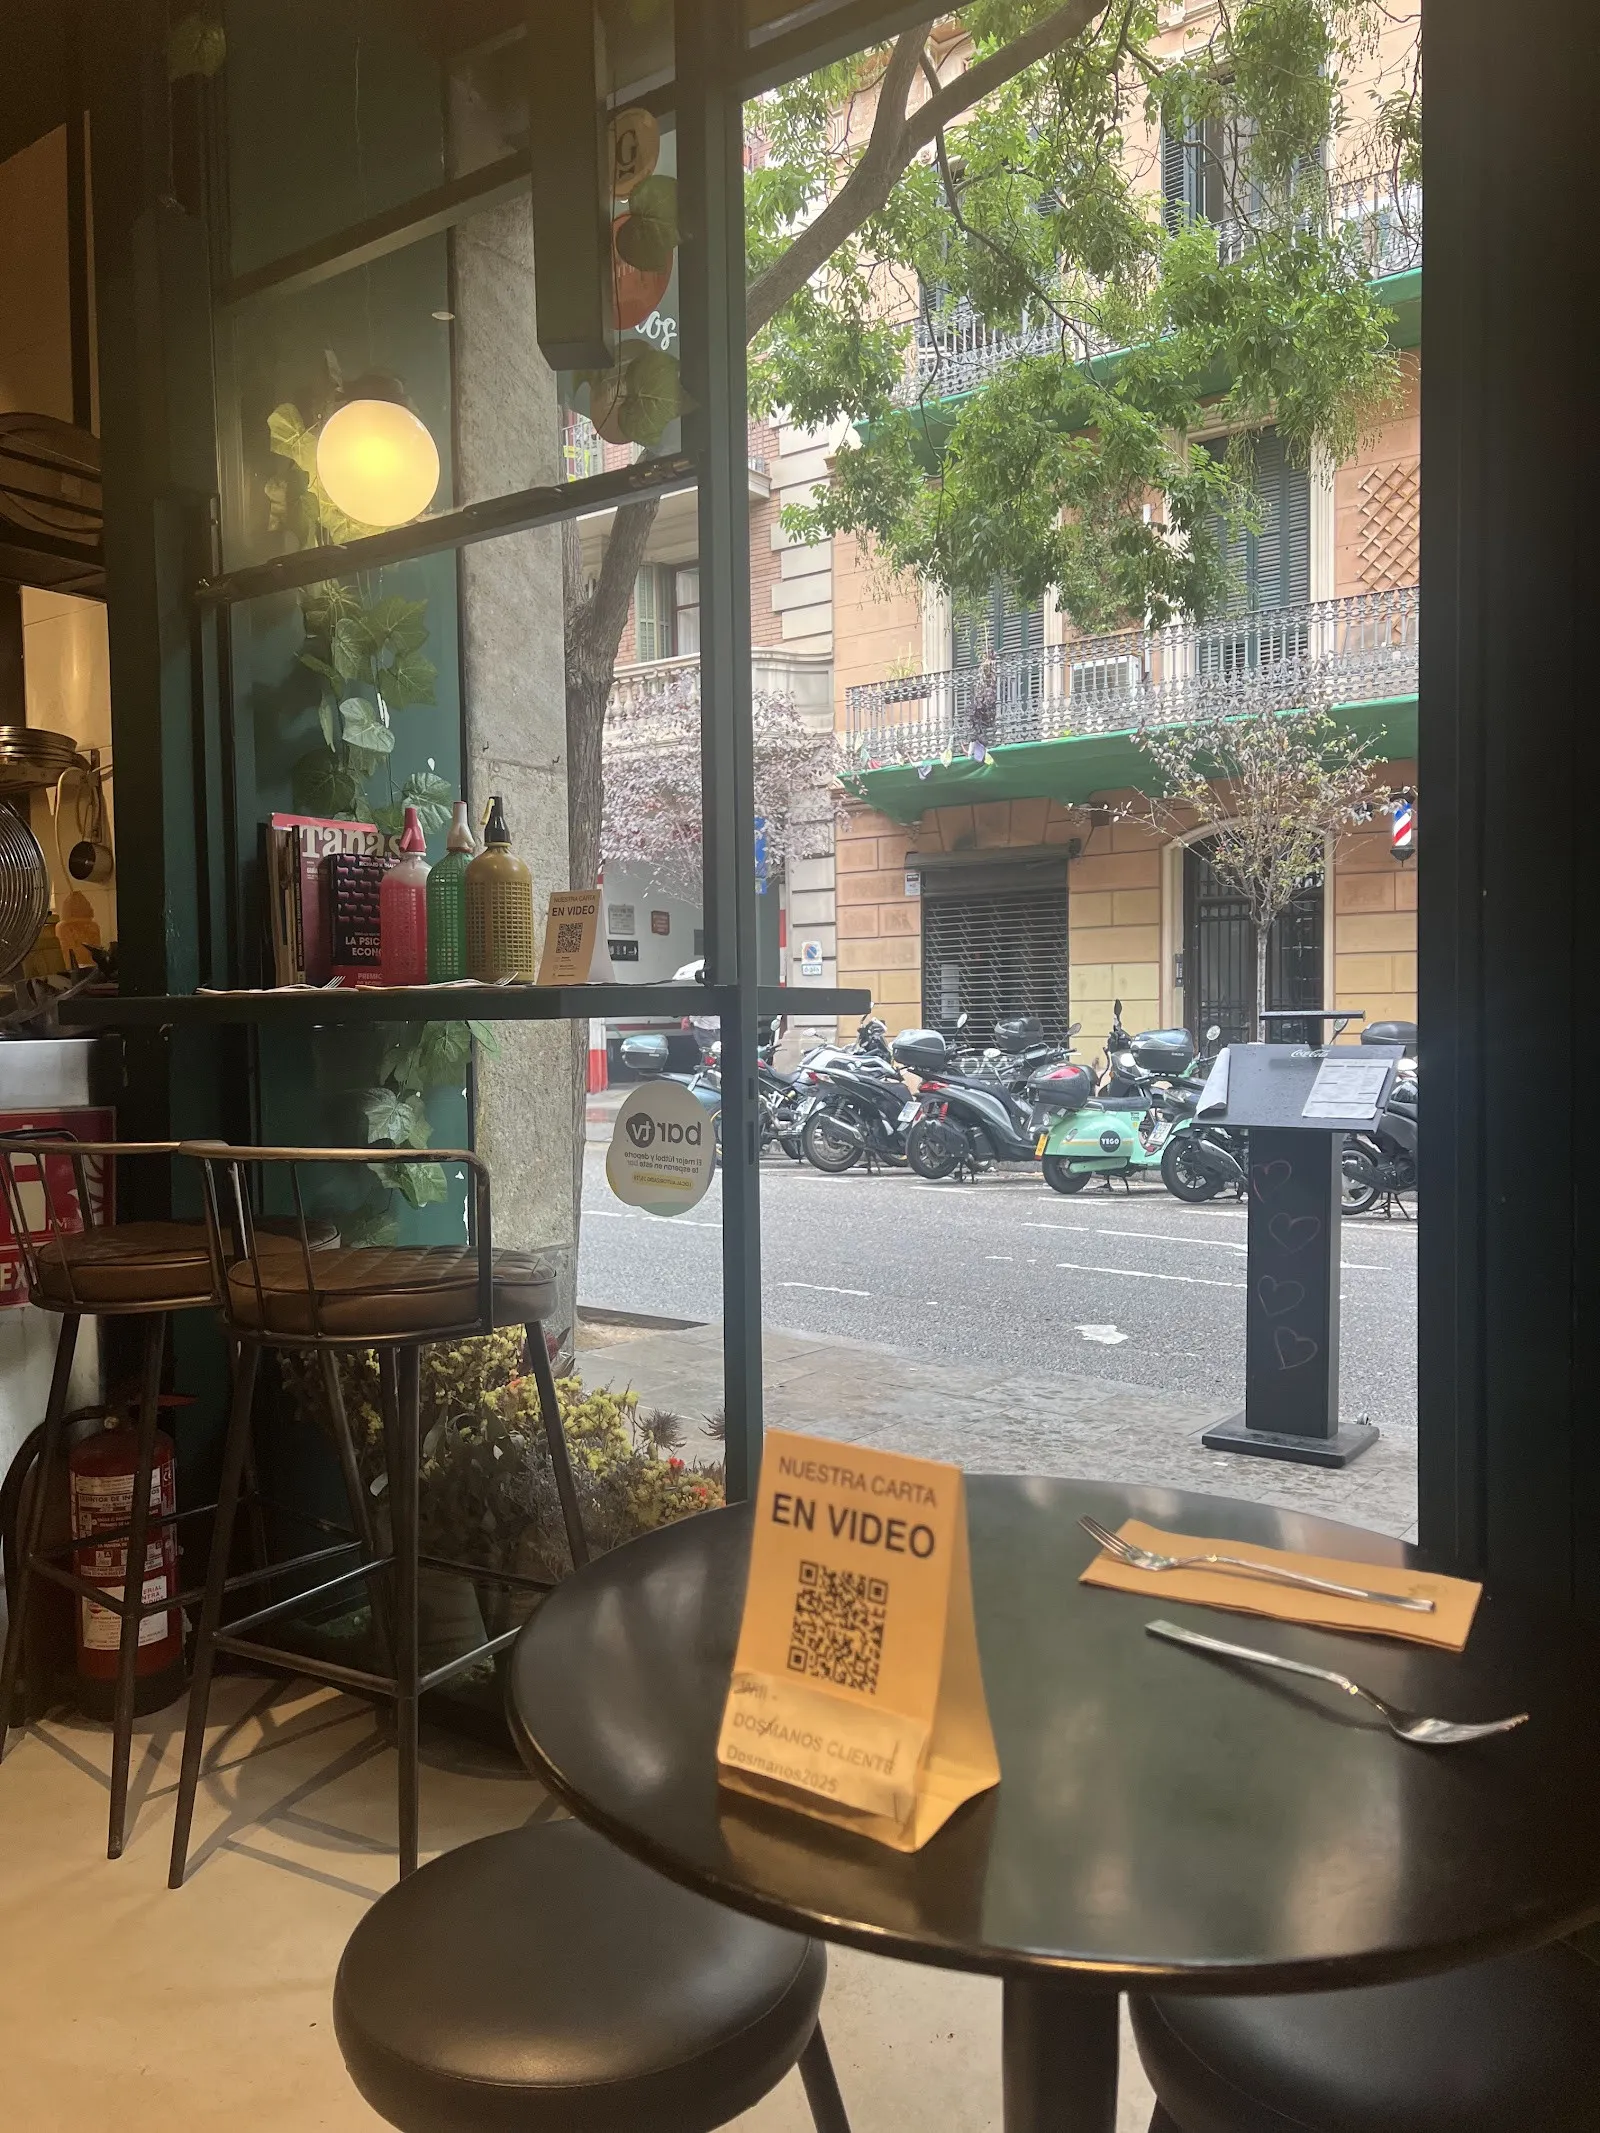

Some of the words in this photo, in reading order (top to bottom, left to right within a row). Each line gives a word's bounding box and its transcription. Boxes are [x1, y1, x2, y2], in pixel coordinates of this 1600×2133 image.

[552, 907, 564, 916] EN
[567, 905, 595, 916] VIDEO
[579, 894, 596, 902] CARTA
[345, 936, 357, 945] LA
[778, 1456, 867, 1492] NUESTRA
[870, 1474, 937, 1508] CARTA
[772, 1492, 816, 1531] EN
[828, 1503, 935, 1558] VIDEO
[733, 1711, 824, 1751] DOSMANOS
[826, 1741, 896, 1775] CLIENTE
[726, 1744, 839, 1794] Dosmanos2025
